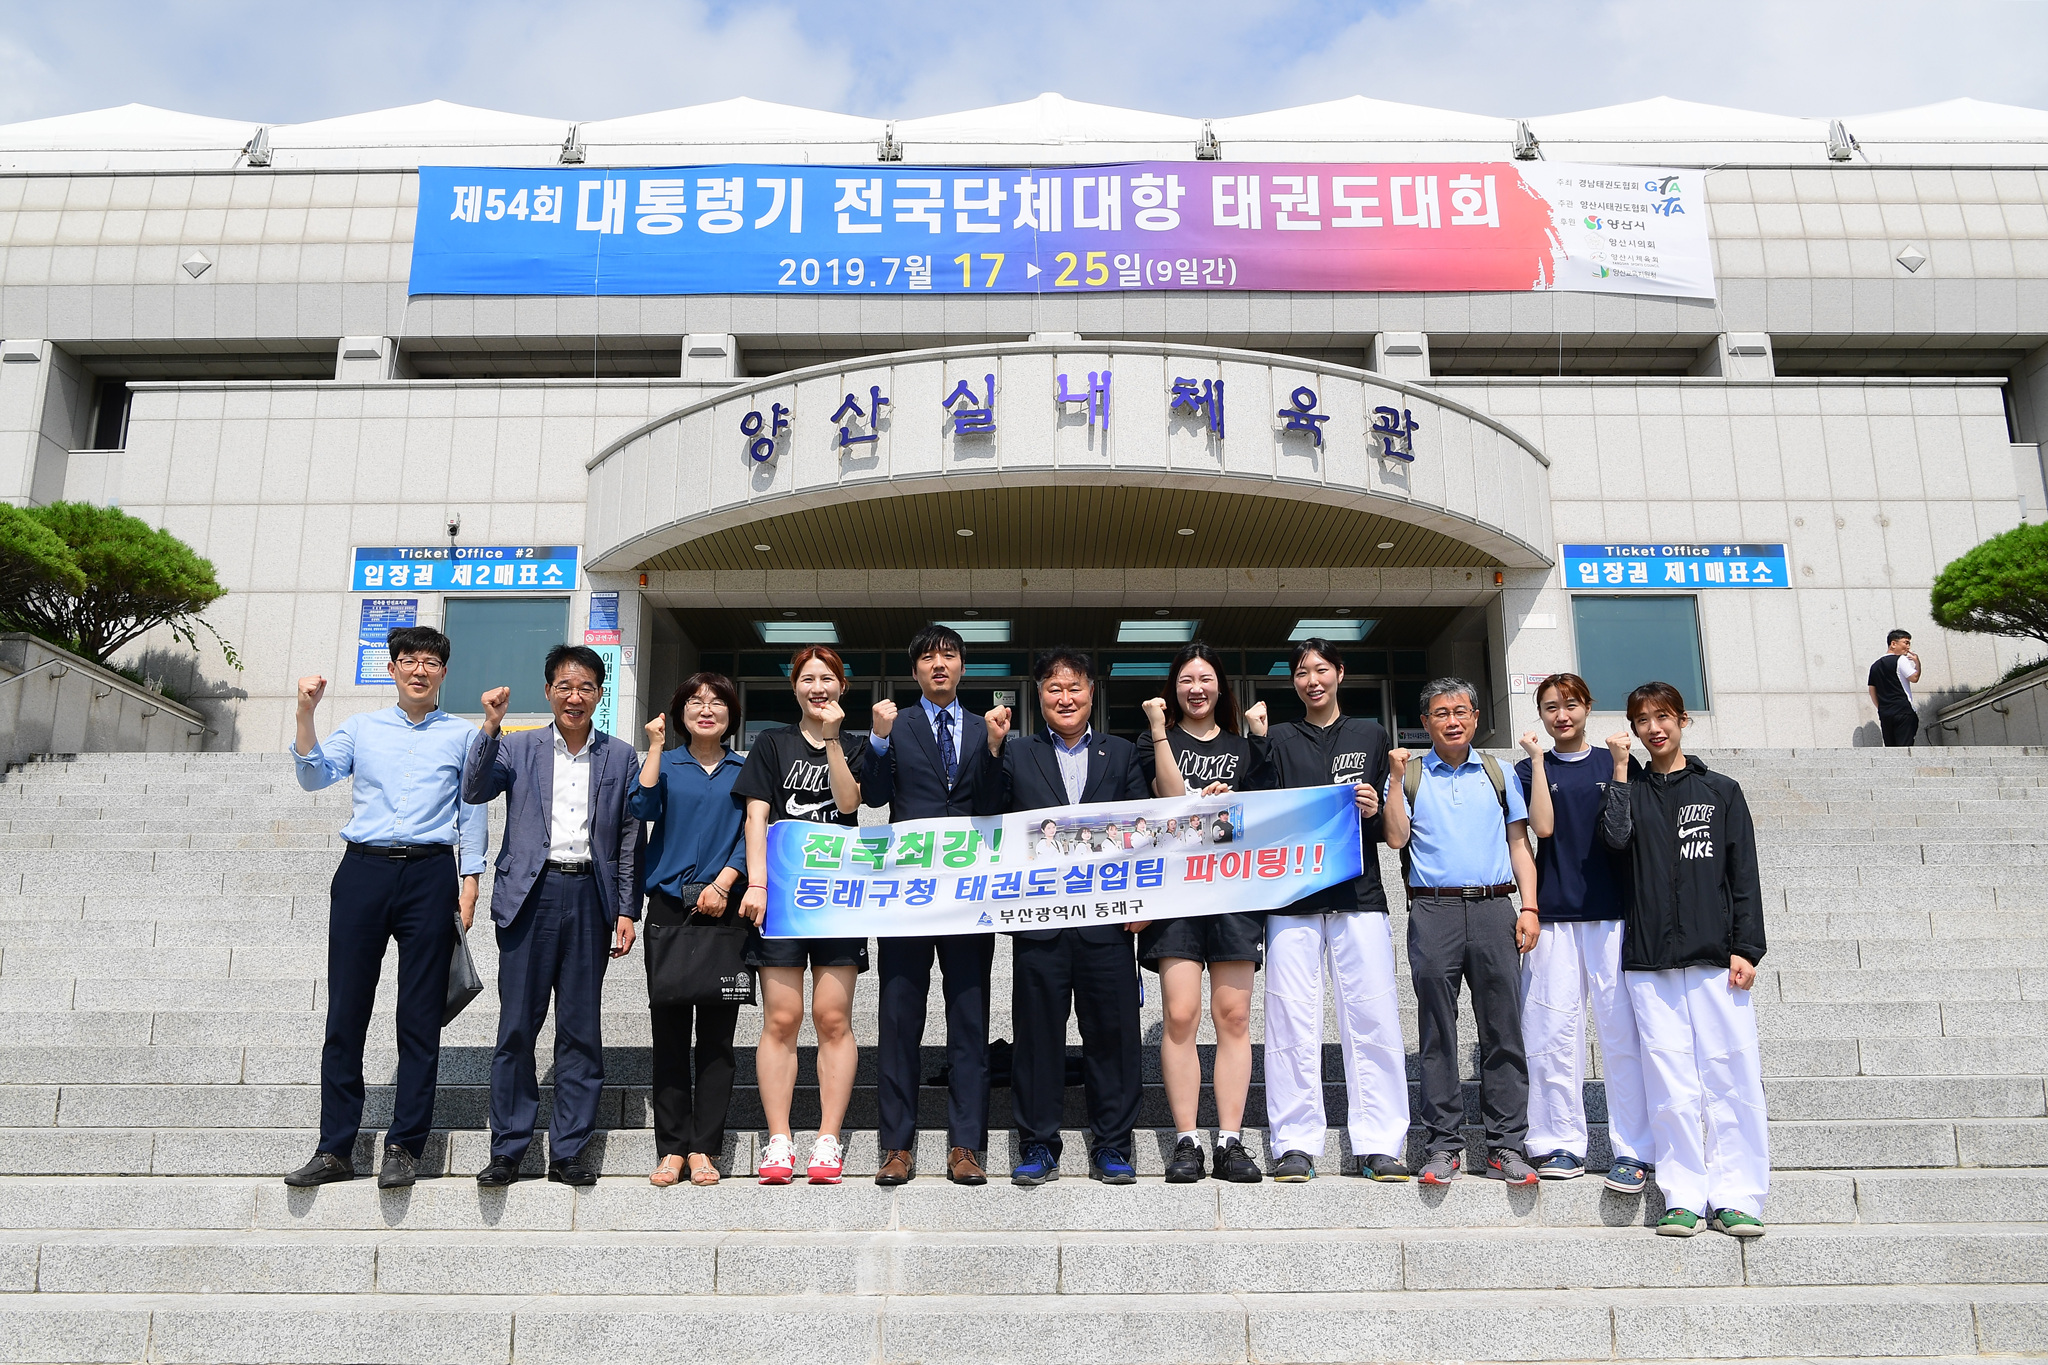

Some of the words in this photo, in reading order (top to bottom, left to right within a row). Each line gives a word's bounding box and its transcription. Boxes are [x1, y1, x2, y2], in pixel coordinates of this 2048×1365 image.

[1557, 178, 1573, 187] 주최
[1578, 179, 1639, 191] 경남태권도협회
[1644, 175, 1682, 195] GTA
[450, 183, 563, 225] 제54회
[575, 178, 803, 235] 대통령기
[833, 174, 1186, 235] 전국단체대항
[1212, 173, 1501, 231] 태권도대회
[1558, 199, 1574, 208] 주관
[1580, 200, 1649, 214] 양산시태권도협회
[1650, 196, 1685, 217] YTA
[1560, 217, 1576, 227] 후원
[1606, 218, 1646, 231] 양산시
[1608, 237, 1656, 250] 양산시의회
[1610, 253, 1659, 264] 양산시체육회
[778, 255, 933, 291] 2019.7월
[953, 251, 1005, 289] 17
[398, 547, 449, 559] Ticket
[455, 547, 504, 559] Office
[515, 547, 534, 558] #2
[1604, 545, 1656, 557] Ticket
[1661, 545, 1711, 557] Office
[1723, 545, 1742, 556] #1
[364, 564, 434, 586] 입장권
[450, 563, 564, 586] 제2매표소
[1578, 561, 1649, 584] 입장권
[1664, 561, 1774, 584] 제1매표소
[599, 686, 612, 735] 임시주거
[1178, 749, 1239, 780] NIKE
[1331, 751, 1367, 774] NIKE
[782, 759, 831, 792] NIK
[1676, 803, 1716, 828] NIKE
[1691, 831, 1711, 839] AIR
[802, 827, 1005, 871] 전국최강!
[1680, 840, 1714, 861] NIKE
[794, 877, 938, 909] 동래구청
[953, 857, 1165, 902] 태권도실업팀
[1184, 844, 1324, 883] 파이팅!!
[999, 904, 1087, 925] 부산광역시
[1095, 899, 1145, 918] 동래구
